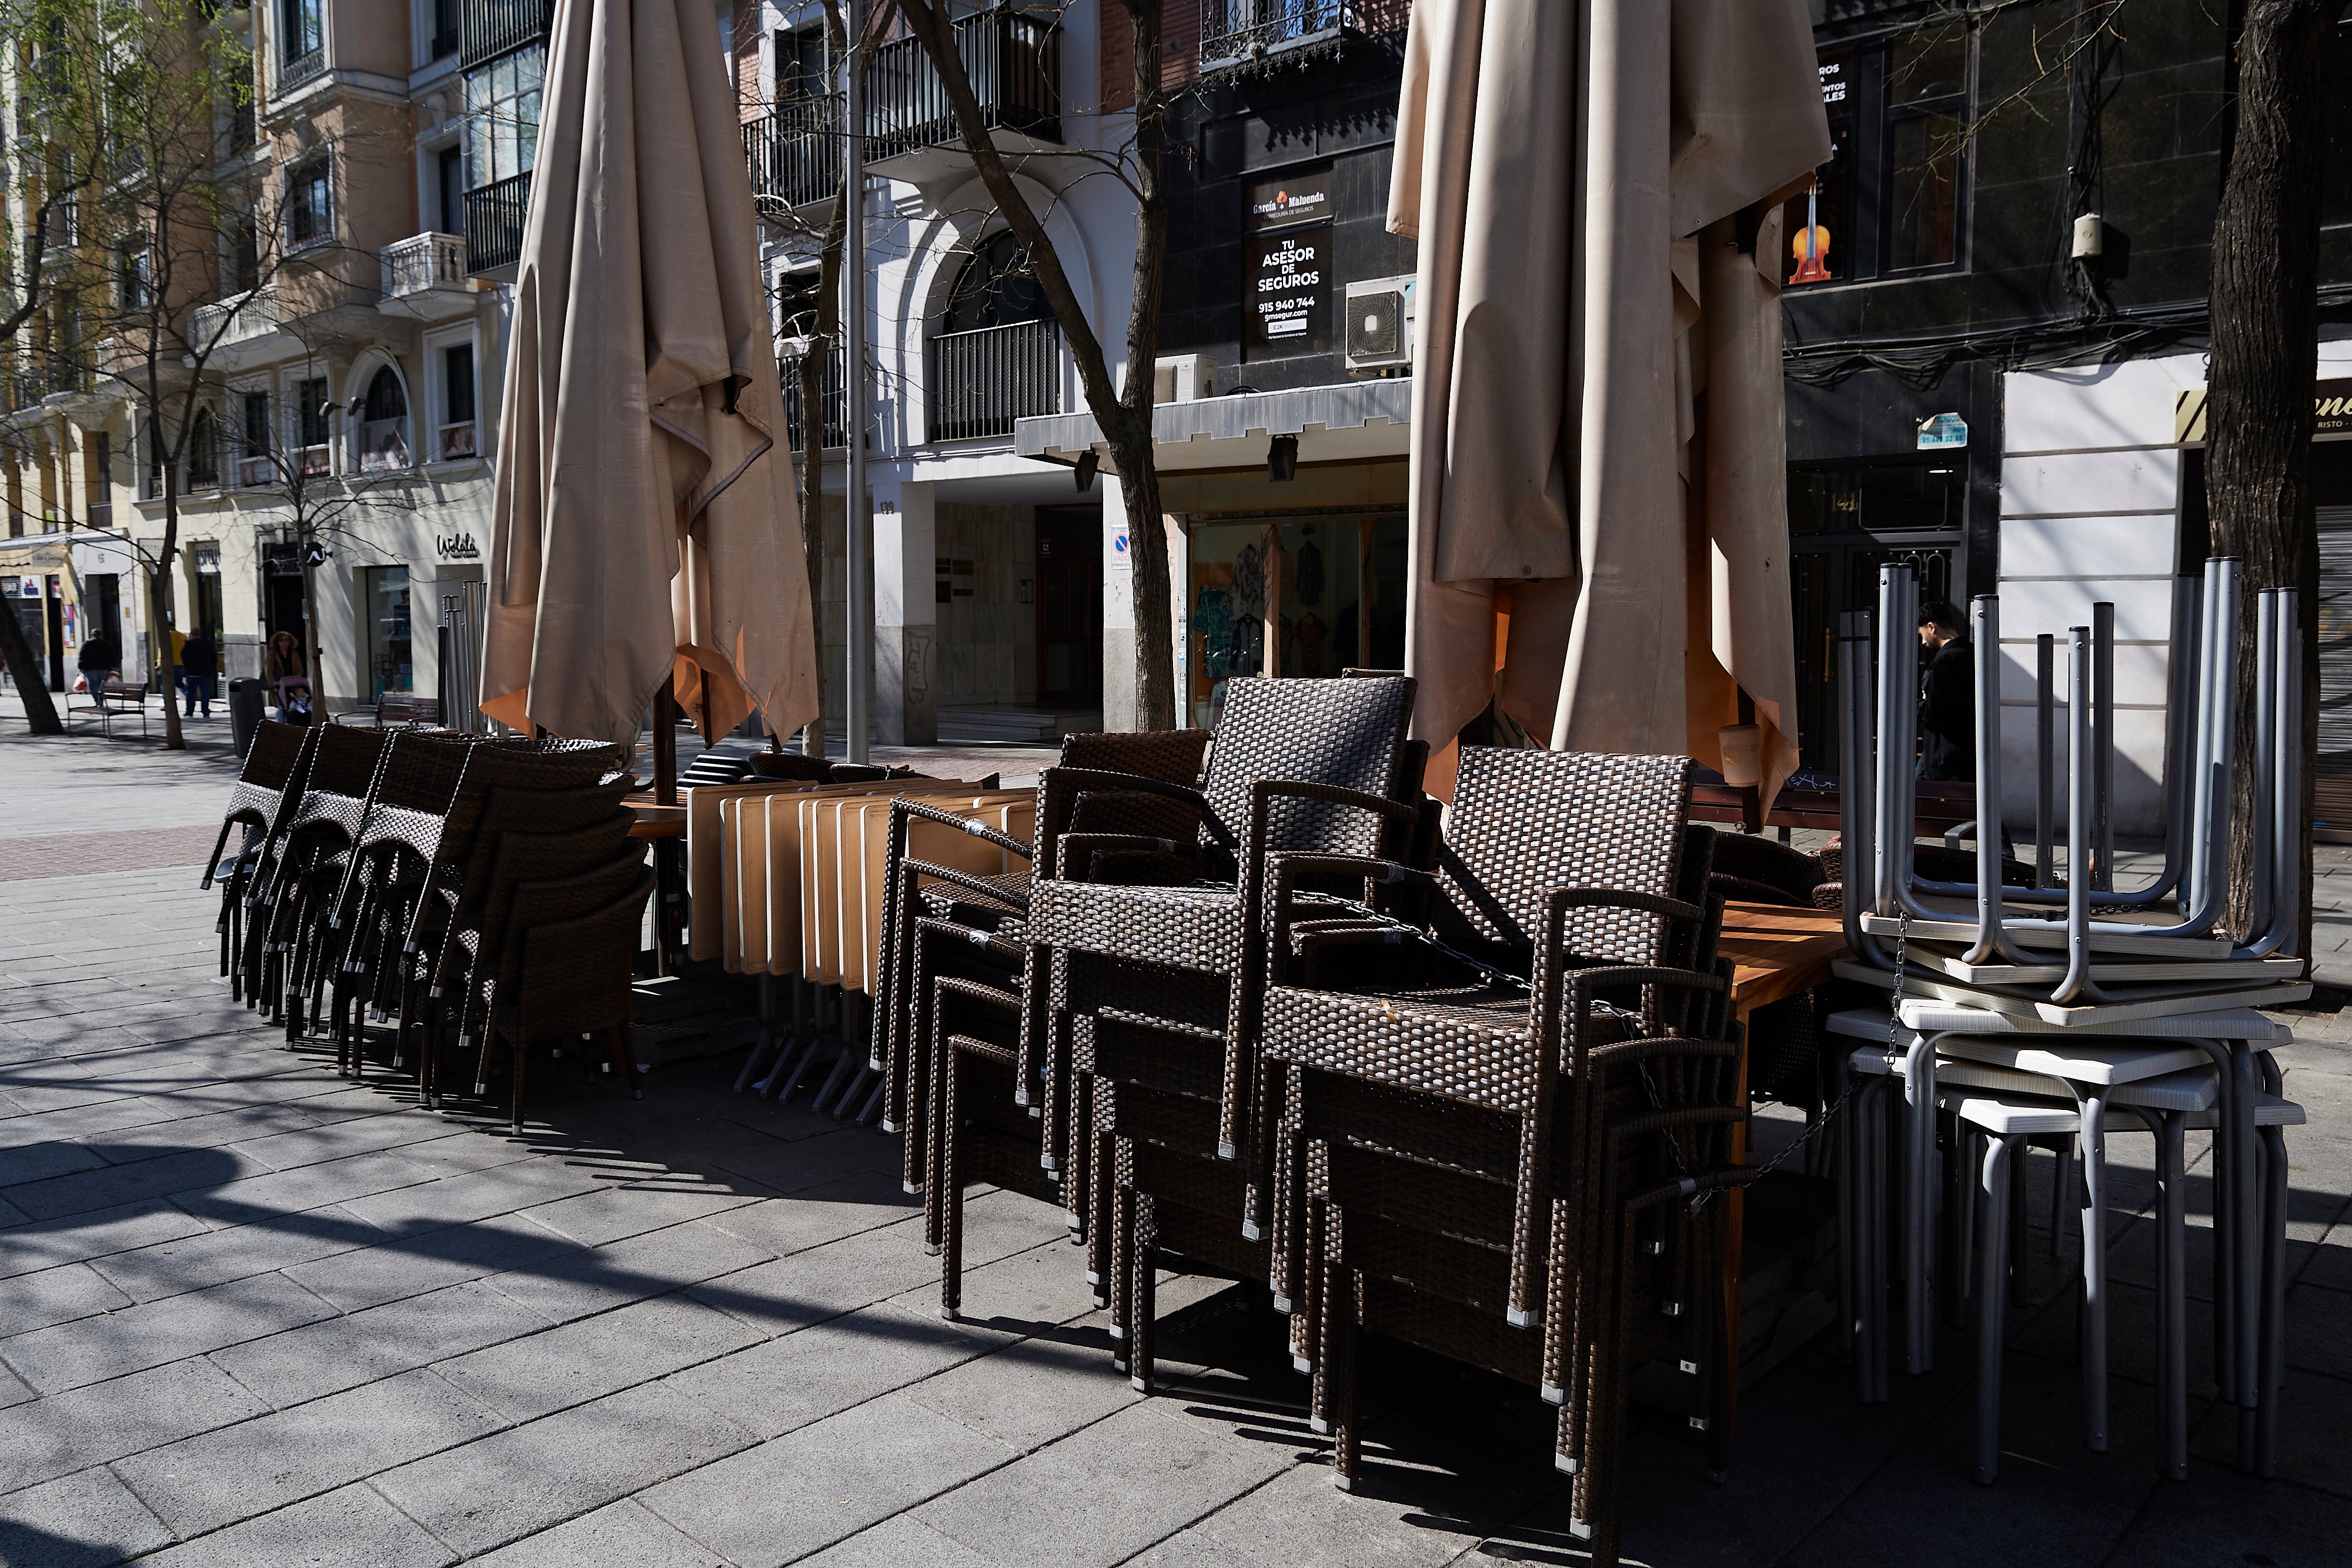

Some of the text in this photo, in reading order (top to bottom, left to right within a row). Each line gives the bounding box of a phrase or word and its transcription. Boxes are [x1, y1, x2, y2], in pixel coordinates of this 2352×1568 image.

[1253, 192, 1325, 214] García Maluenda
[1295, 205, 1314, 213] SEGUROS
[1282, 239, 1295, 250] TU
[1262, 247, 1315, 267] ASESOR
[1282, 263, 1295, 275] DE
[1258, 271, 1319, 292] SEGUROS
[1259, 296, 1315, 313] 915 940 744
[1264, 309, 1308, 322] gmsegur.com
[880, 501, 894, 514] 139
[1831, 493, 1856, 511] 141
